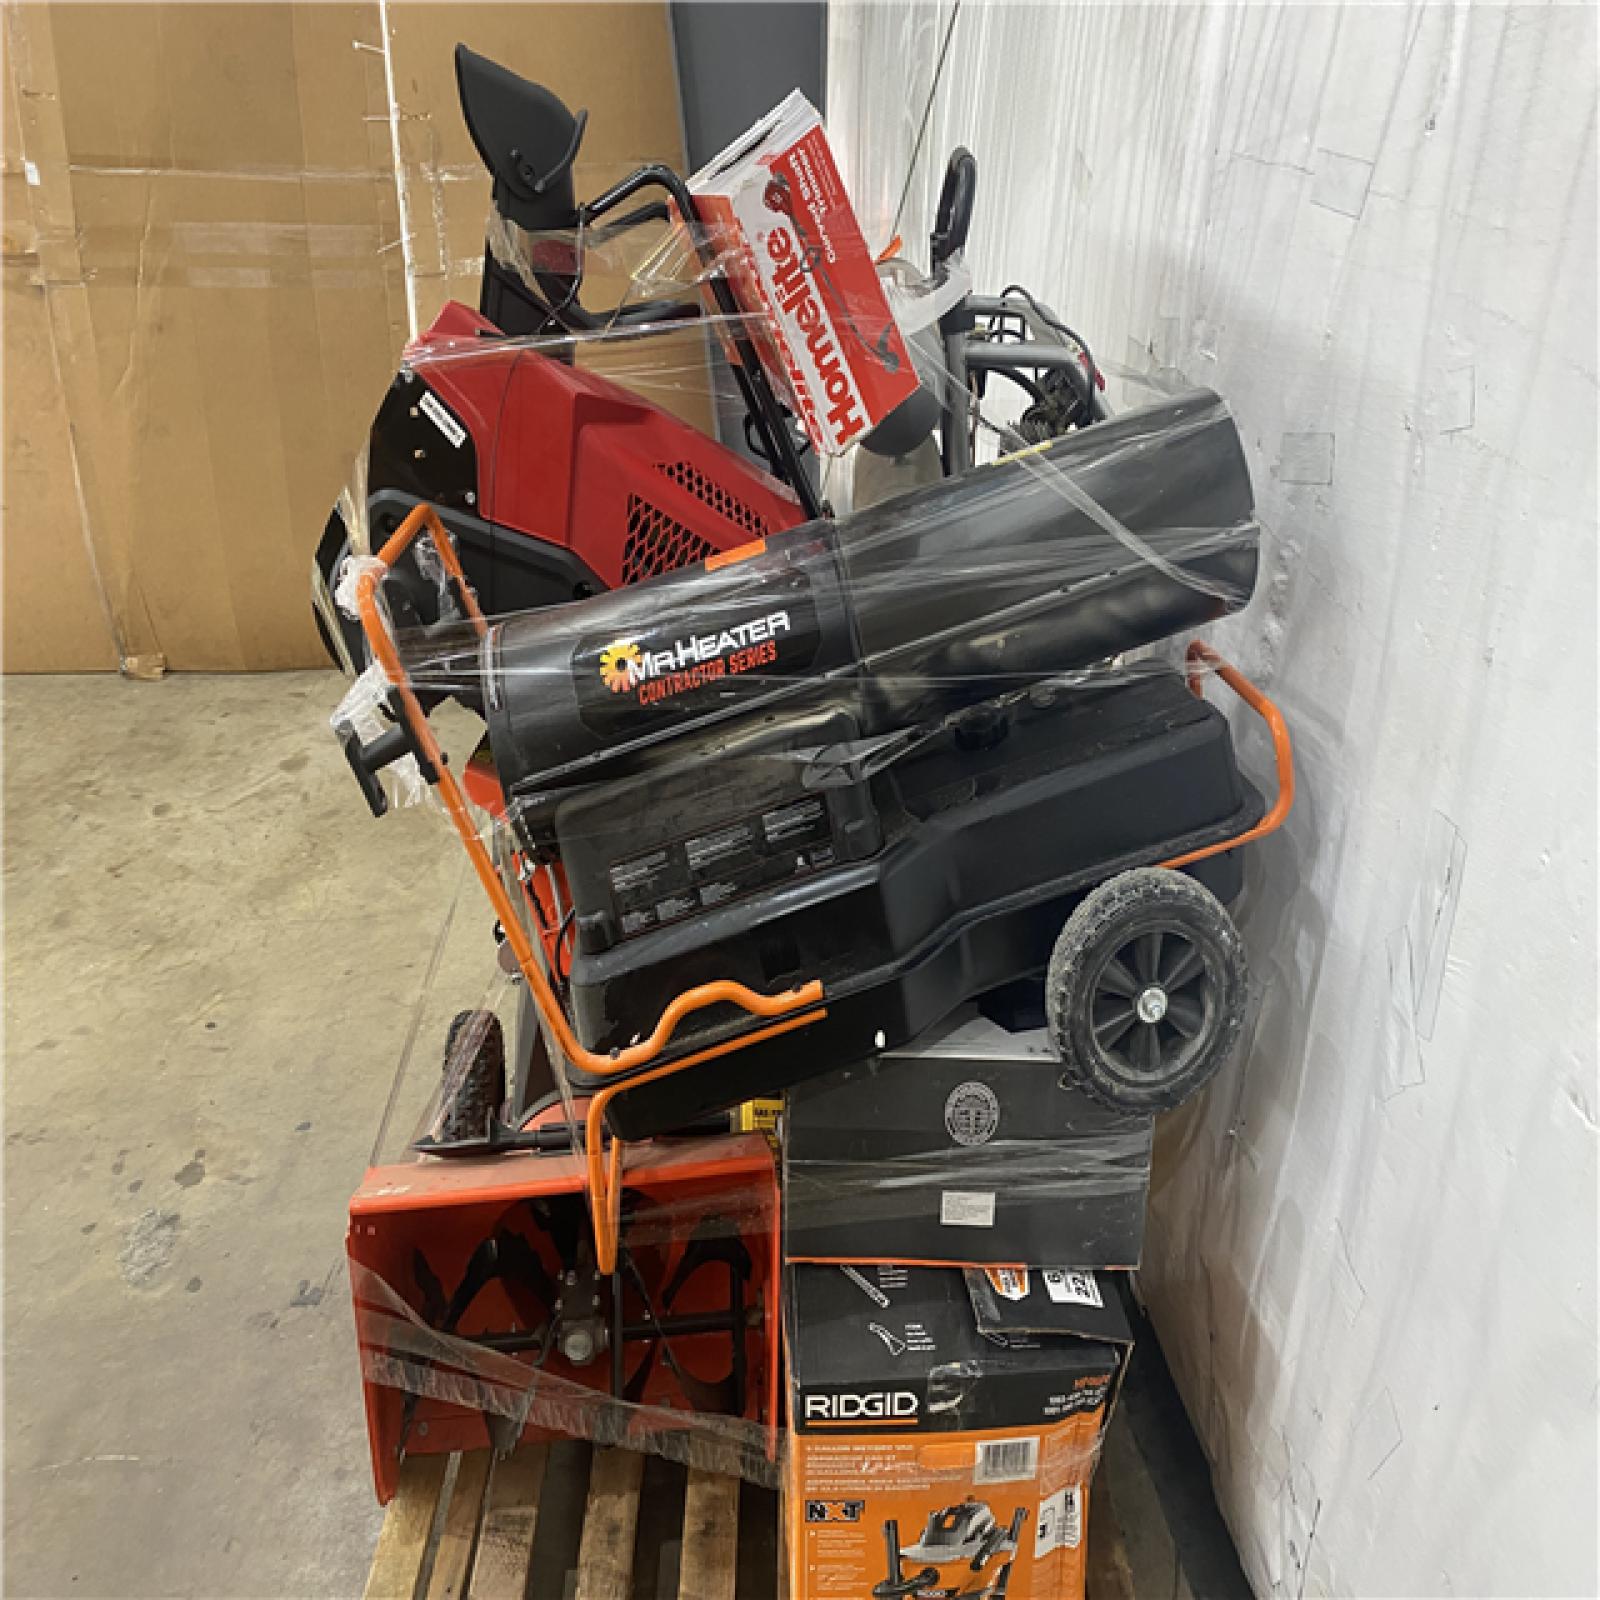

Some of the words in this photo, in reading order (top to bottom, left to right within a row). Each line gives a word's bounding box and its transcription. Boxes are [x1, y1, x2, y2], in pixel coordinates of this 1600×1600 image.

[767, 227, 865, 446] Homelite
[639, 658, 726, 706] CONTRACTOR
[729, 639, 778, 674] SERIES
[804, 1392, 919, 1419] RIDGID
